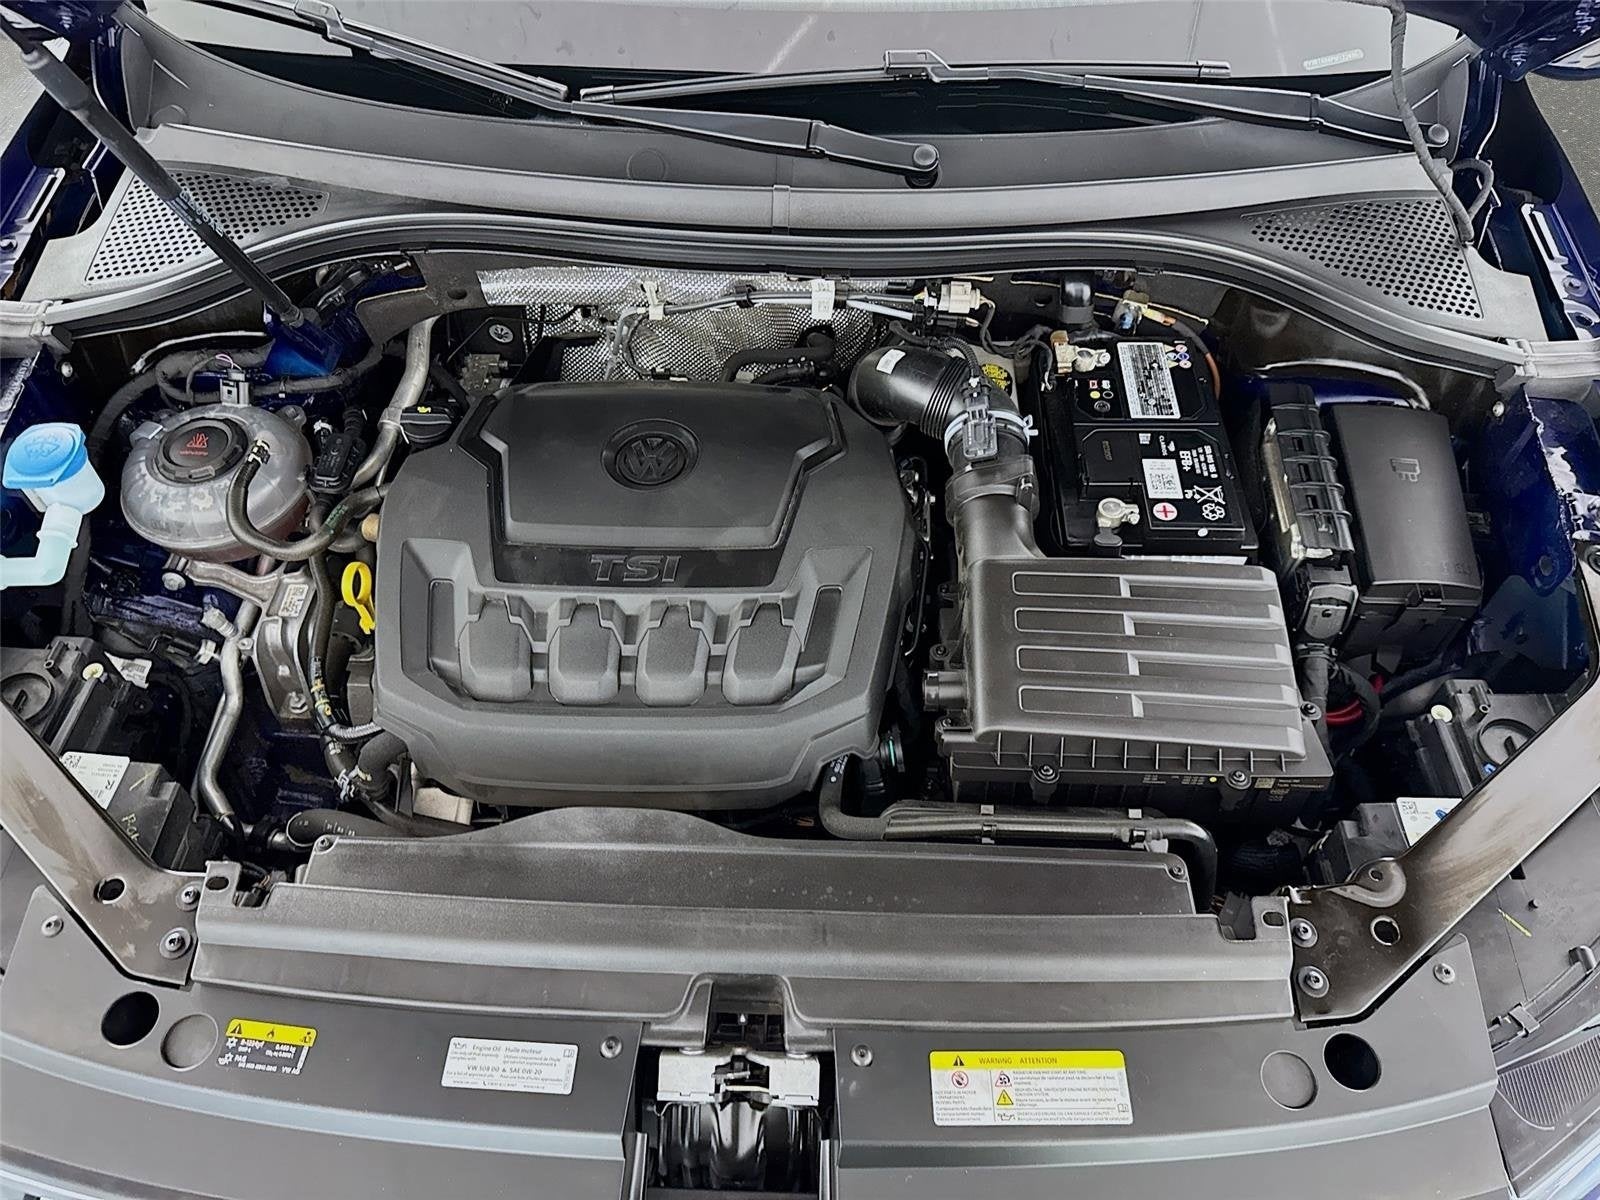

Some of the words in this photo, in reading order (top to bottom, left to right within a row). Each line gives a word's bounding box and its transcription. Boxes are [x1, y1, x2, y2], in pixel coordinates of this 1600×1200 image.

[1179, 450, 1193, 472] EFB+
[590, 554, 682, 582] TSI
[472, 1044, 491, 1053] Engine
[978, 1056, 1013, 1065] WARNING
[1019, 1056, 1058, 1065] ATTENTION
